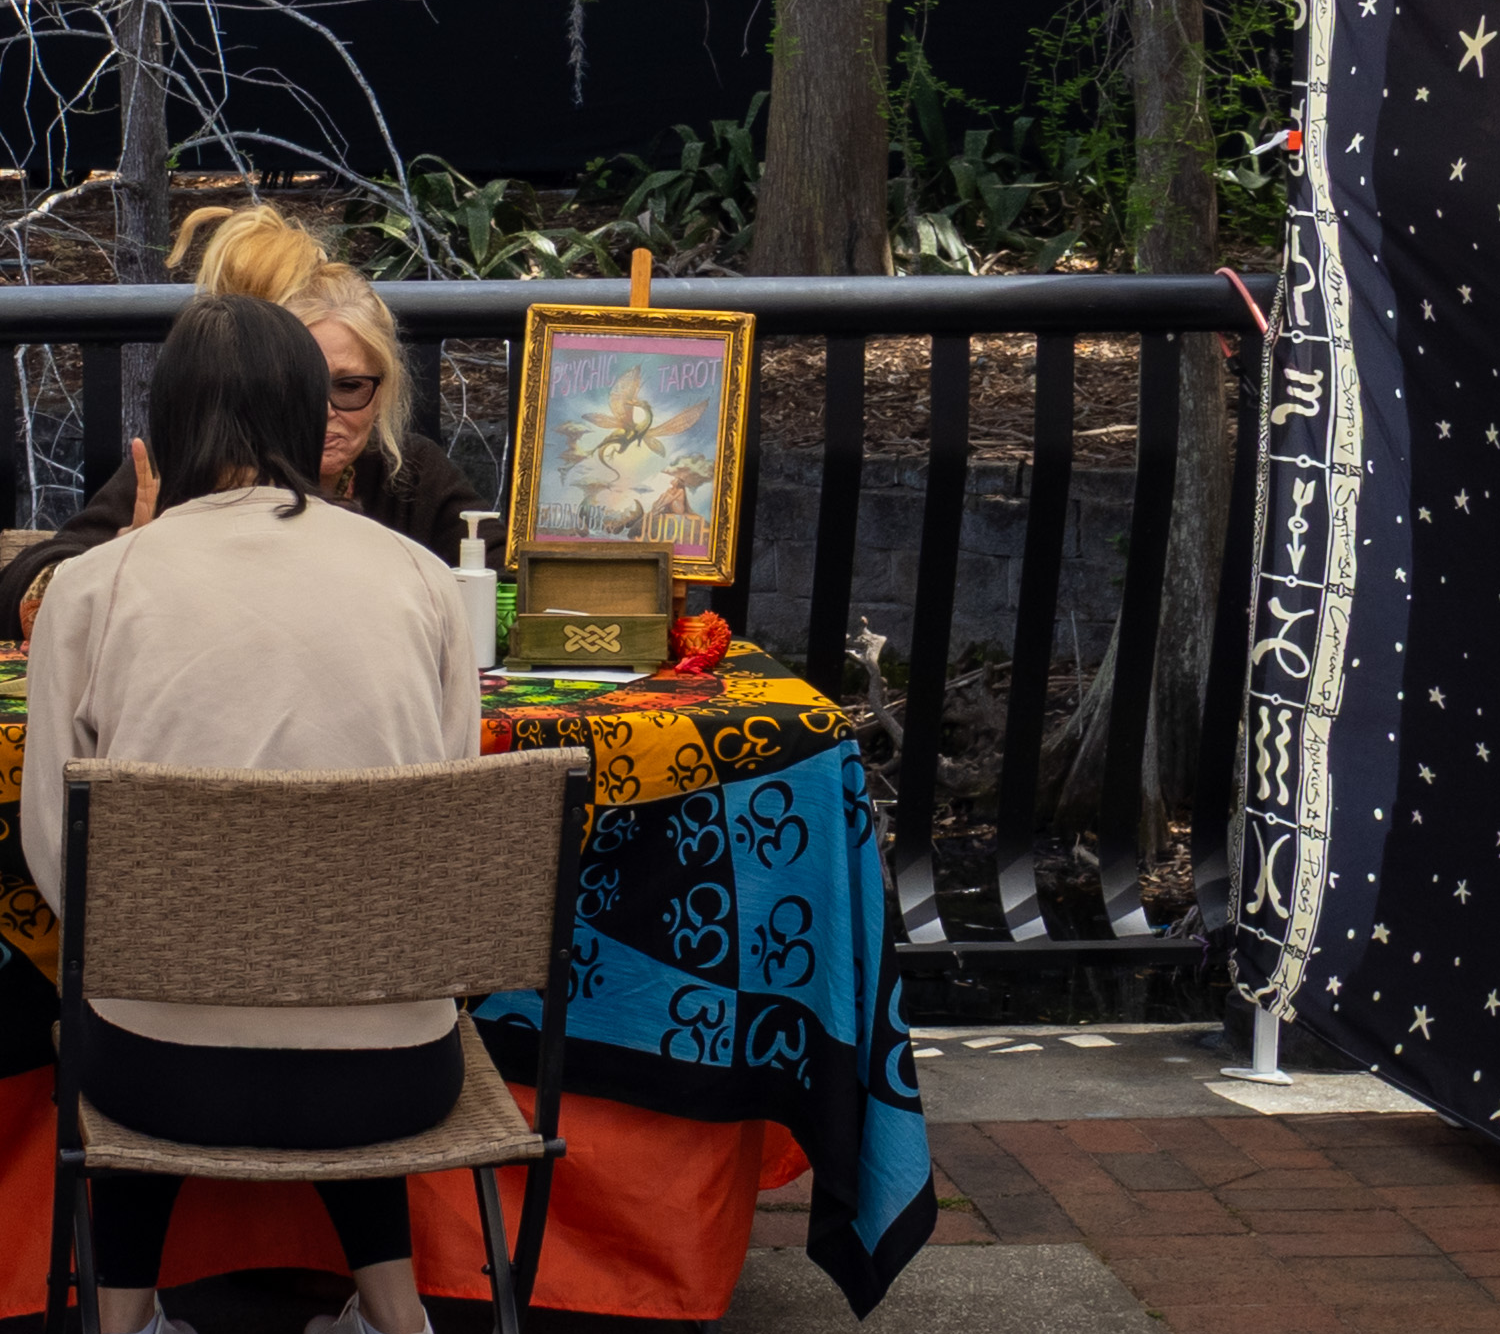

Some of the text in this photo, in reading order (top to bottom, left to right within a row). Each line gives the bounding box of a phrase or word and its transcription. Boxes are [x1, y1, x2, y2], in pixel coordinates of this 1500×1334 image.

[549, 353, 722, 399] PSYCHIC TAROT
[537, 502, 586, 532] EADING
